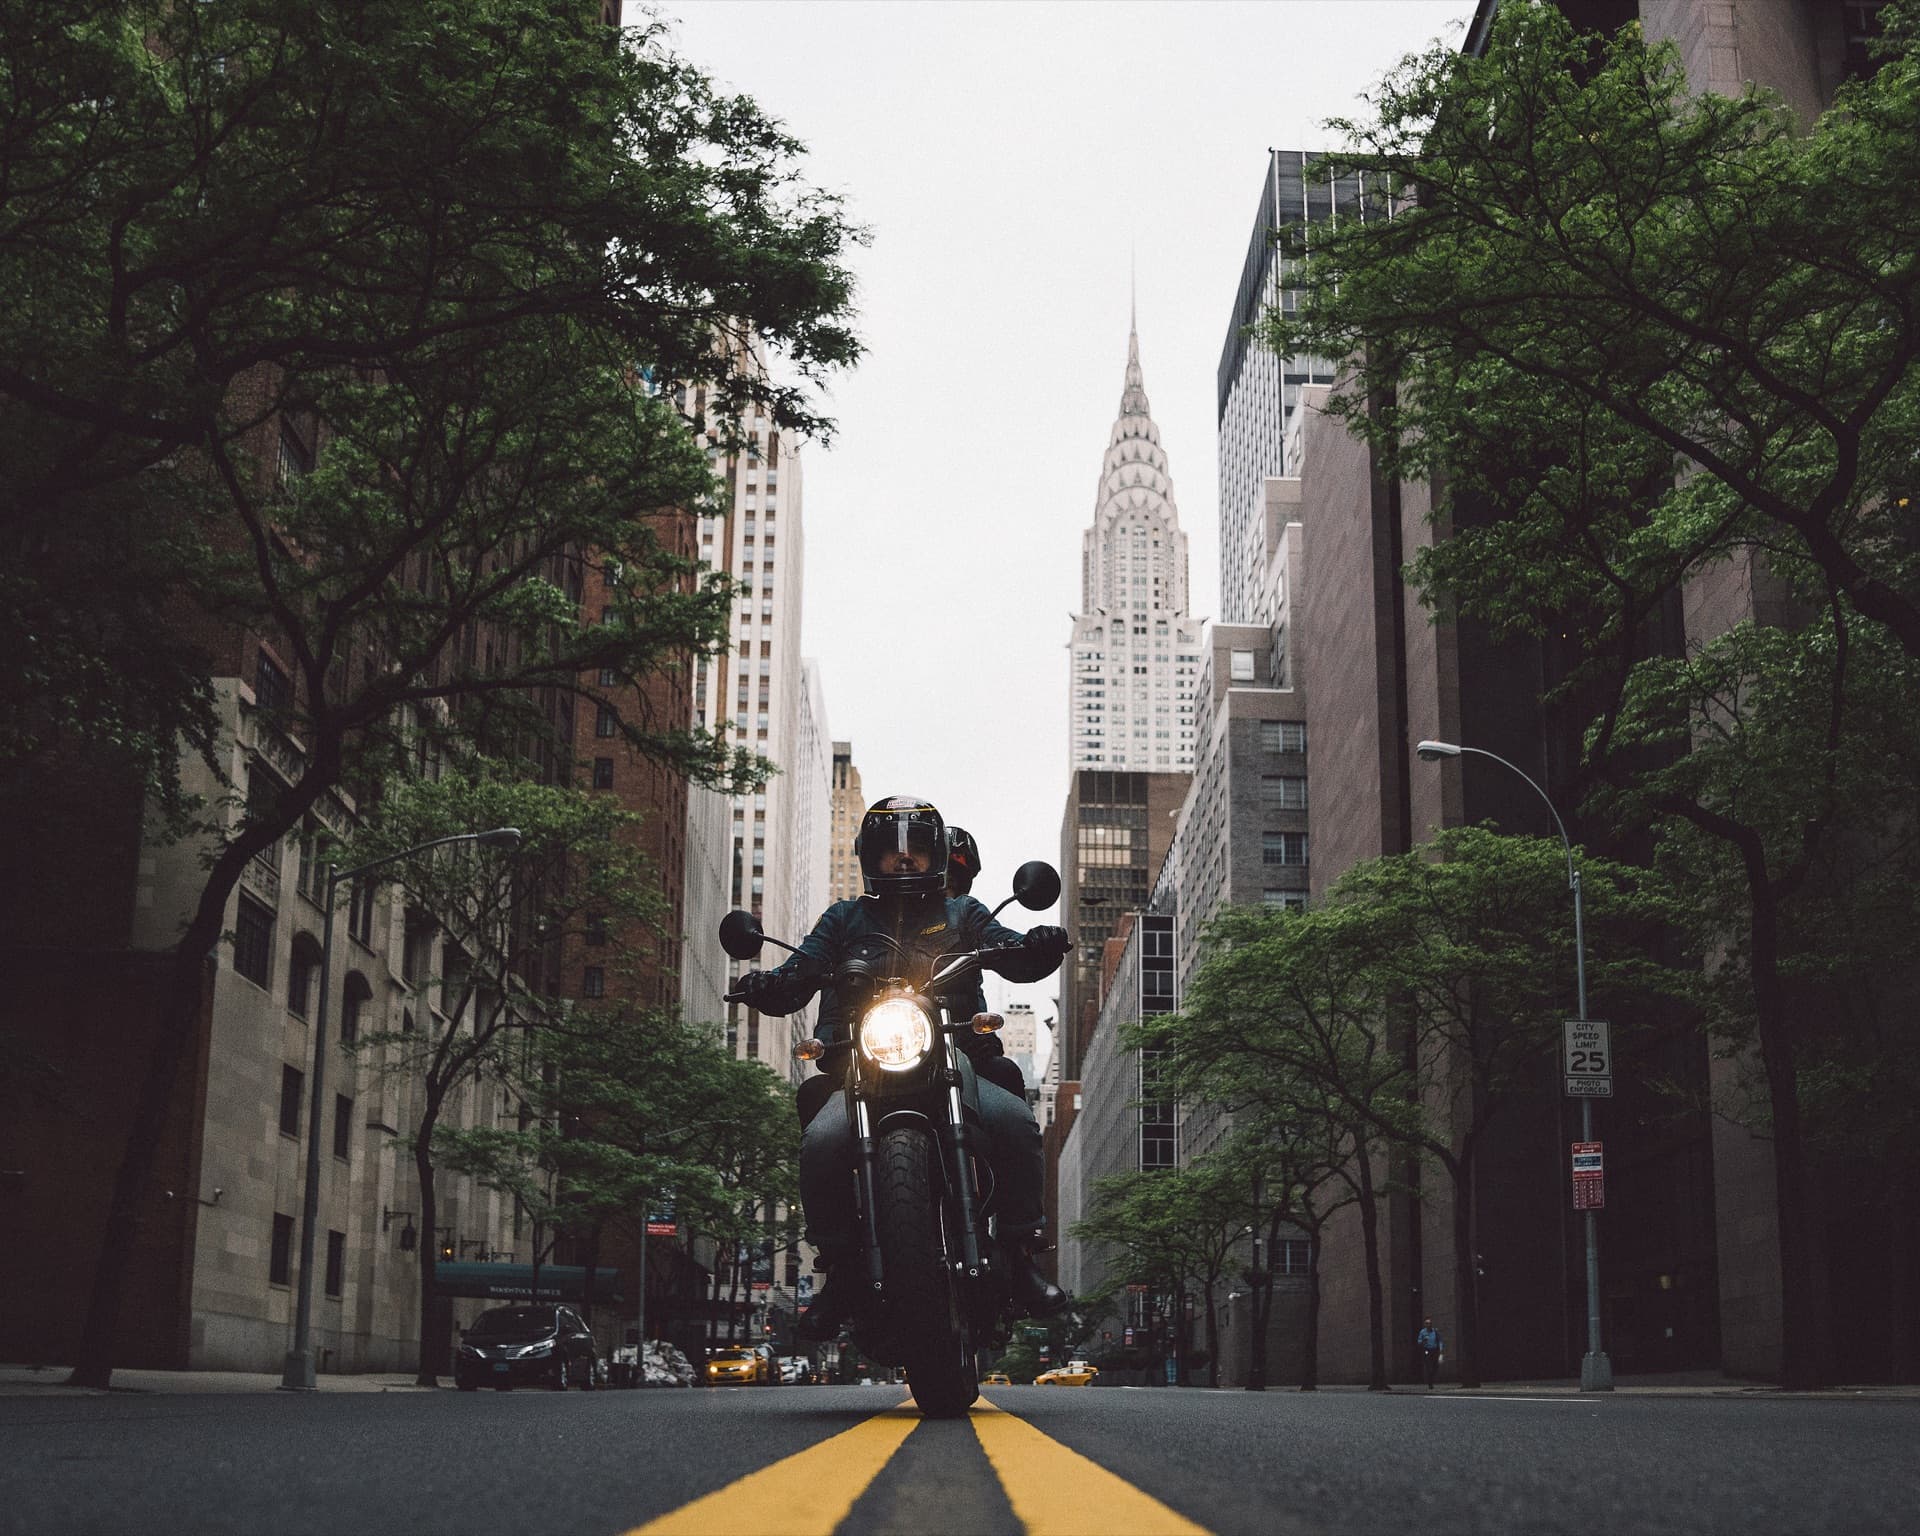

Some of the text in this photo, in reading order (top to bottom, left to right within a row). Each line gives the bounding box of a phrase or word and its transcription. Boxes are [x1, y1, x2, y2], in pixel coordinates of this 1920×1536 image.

[1576, 1023, 1595, 1031] CITY
[1572, 1031, 1600, 1040] SPEED
[1571, 1050, 1606, 1072] 25
